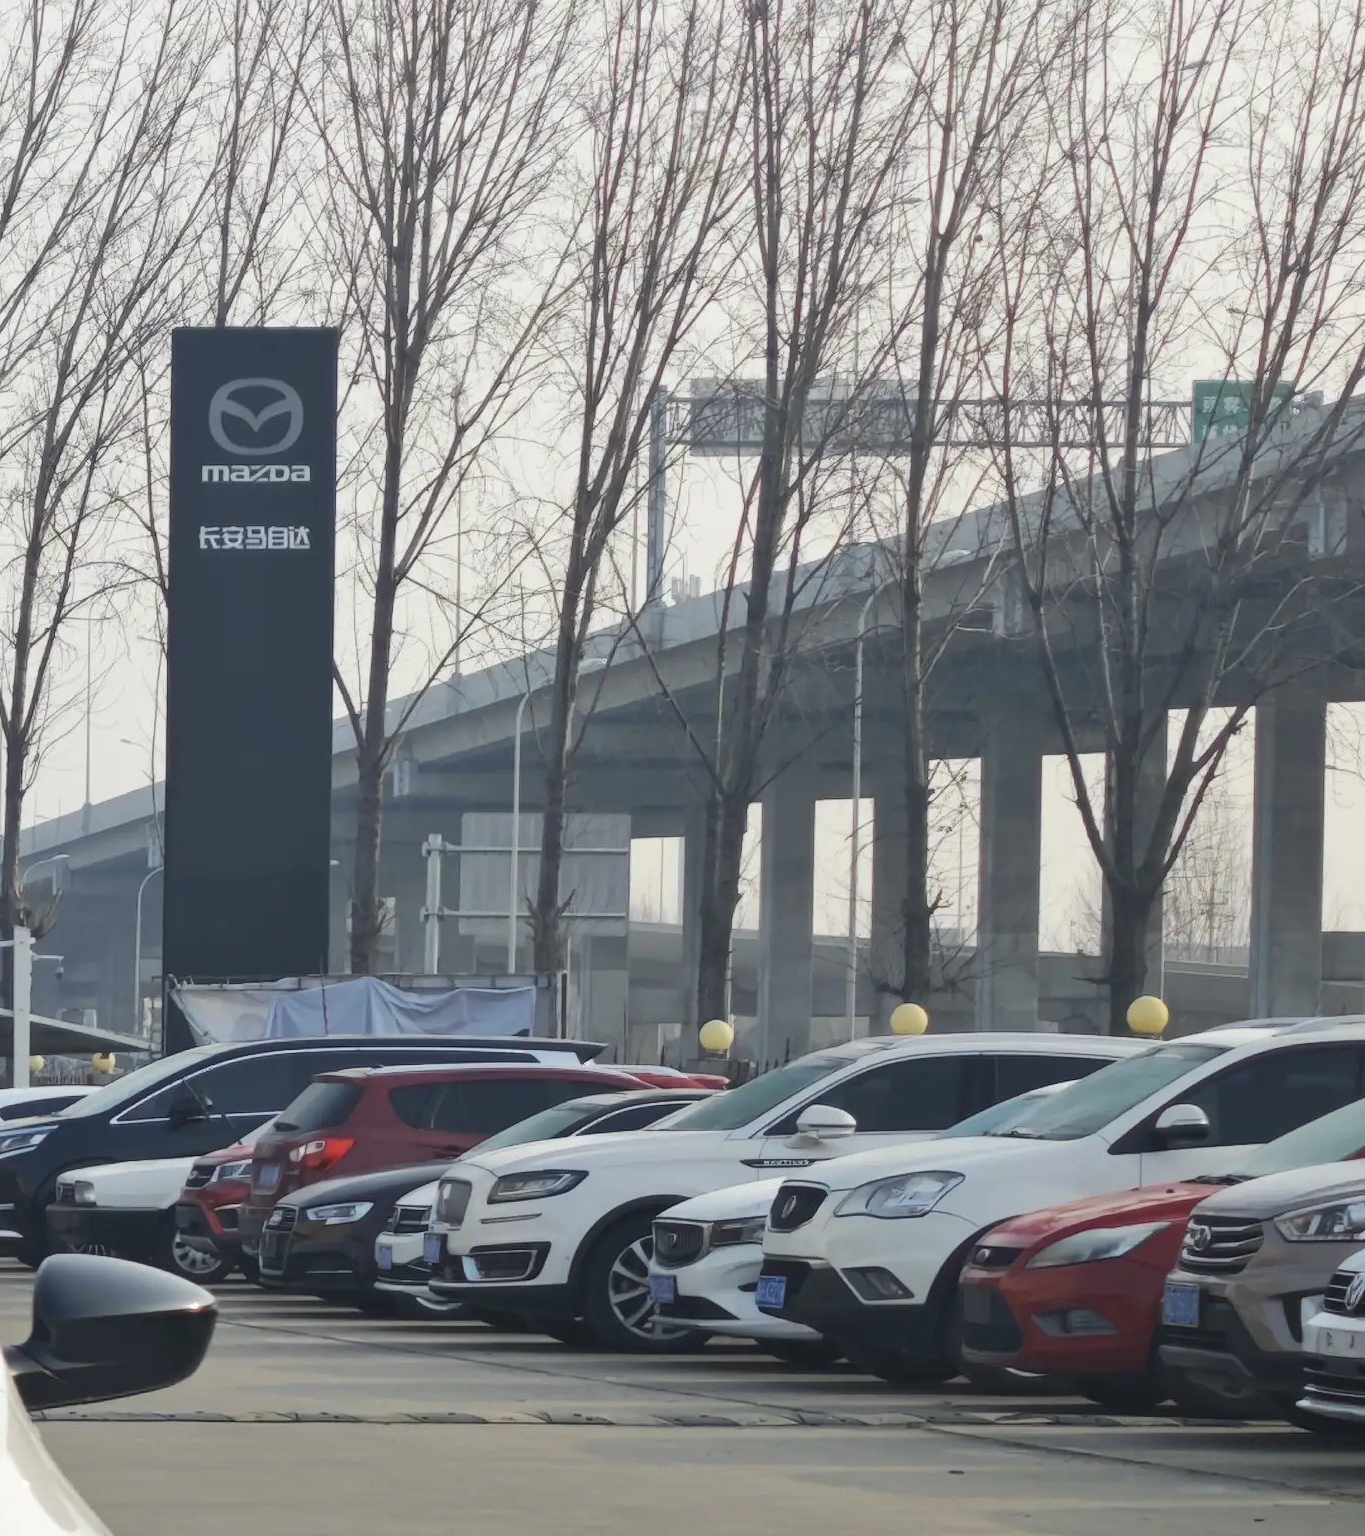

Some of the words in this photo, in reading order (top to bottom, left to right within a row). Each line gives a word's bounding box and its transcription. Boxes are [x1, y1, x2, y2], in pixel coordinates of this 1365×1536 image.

[198, 525, 311, 550] 长安马自达
